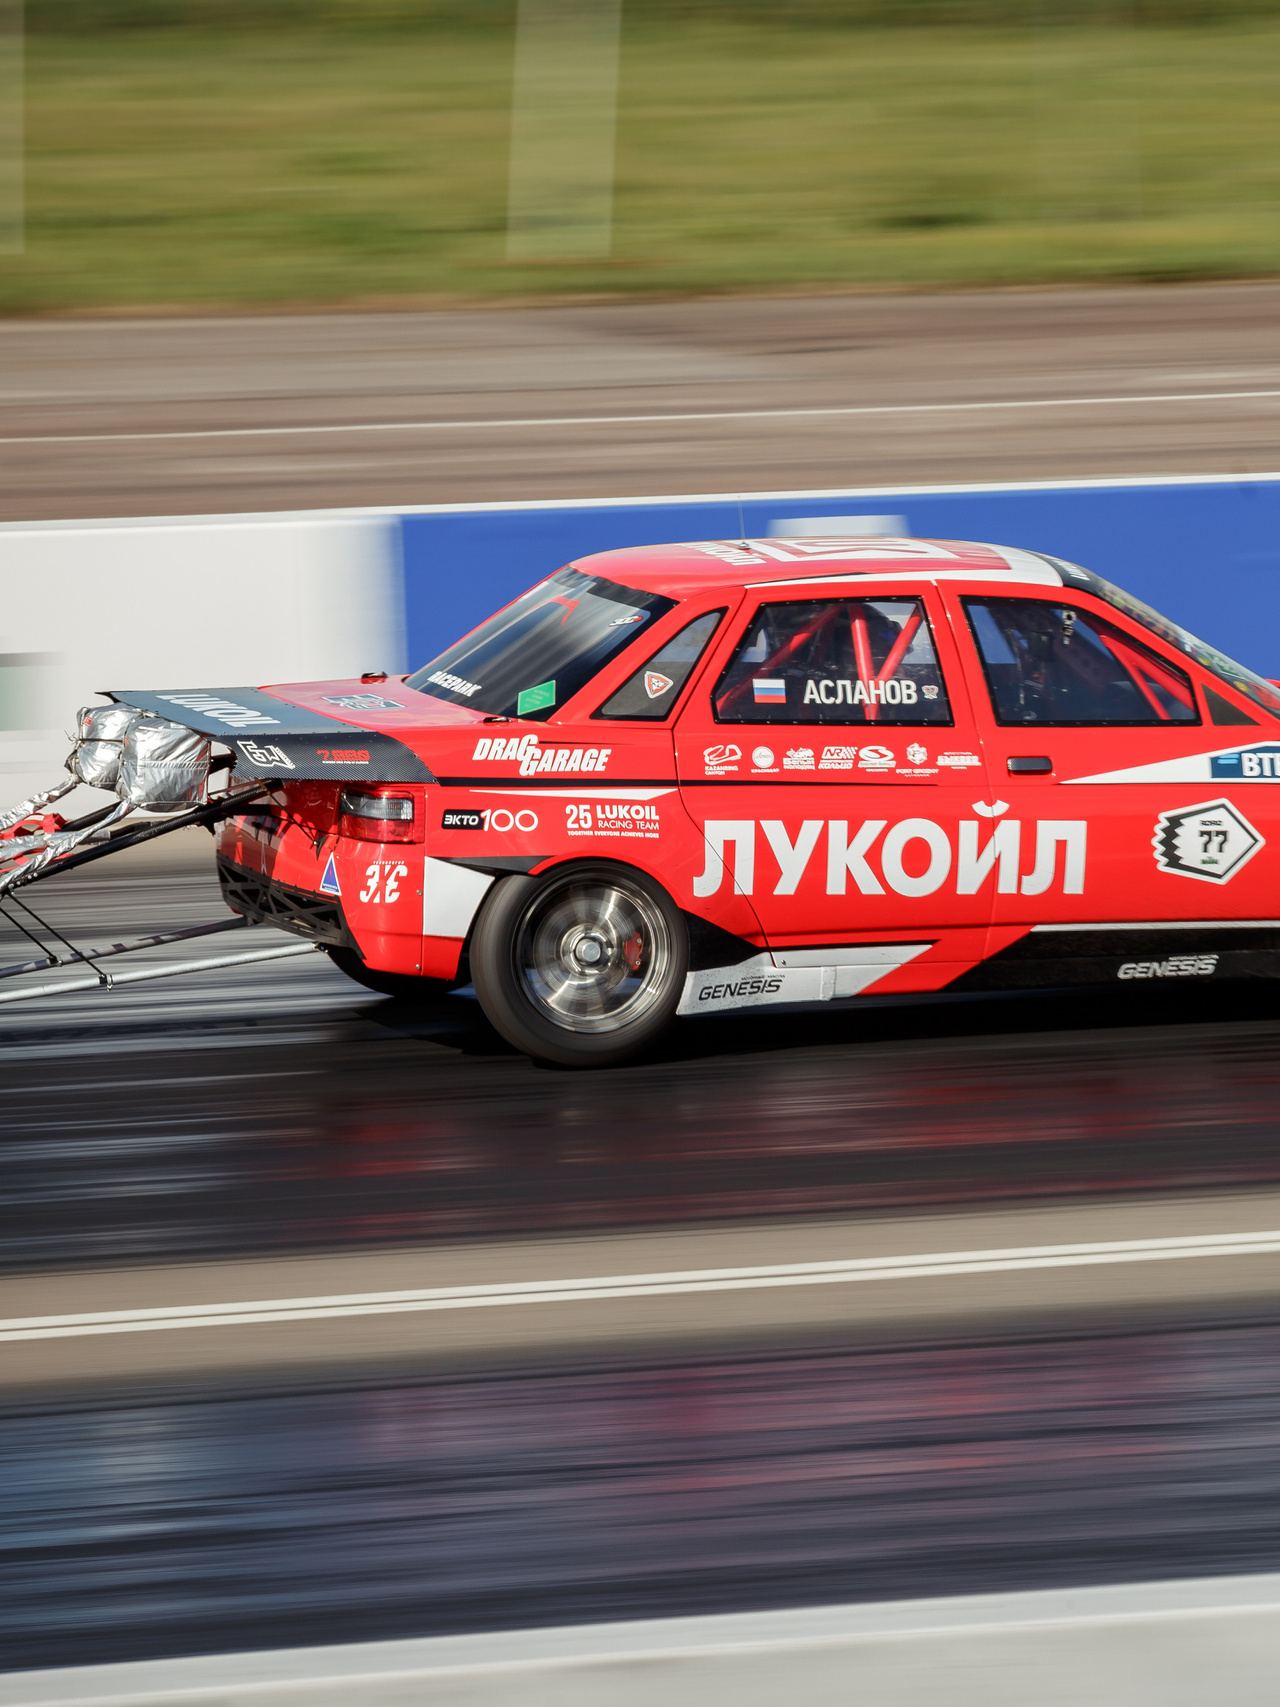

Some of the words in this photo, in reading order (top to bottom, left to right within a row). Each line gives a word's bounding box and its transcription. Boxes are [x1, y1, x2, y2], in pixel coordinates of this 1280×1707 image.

[427, 670, 483, 698] RACEPARK
[803, 679, 919, 704] АСЛАНОВ
[155, 693, 282, 729] LUKOIL
[519, 748, 612, 777] GARAGE
[443, 813, 480, 826] ЭКТО
[480, 808, 539, 832] 100
[565, 804, 593, 829] 25
[596, 804, 660, 821] LUKOIL
[597, 819, 633, 830] RACING
[635, 821, 660, 831] TEAM
[693, 799, 1088, 898] ЛУКОЙЛ
[1198, 830, 1228, 853] 77
[1117, 959, 1217, 979] GENESIS
[699, 979, 782, 1001] GENESIS
